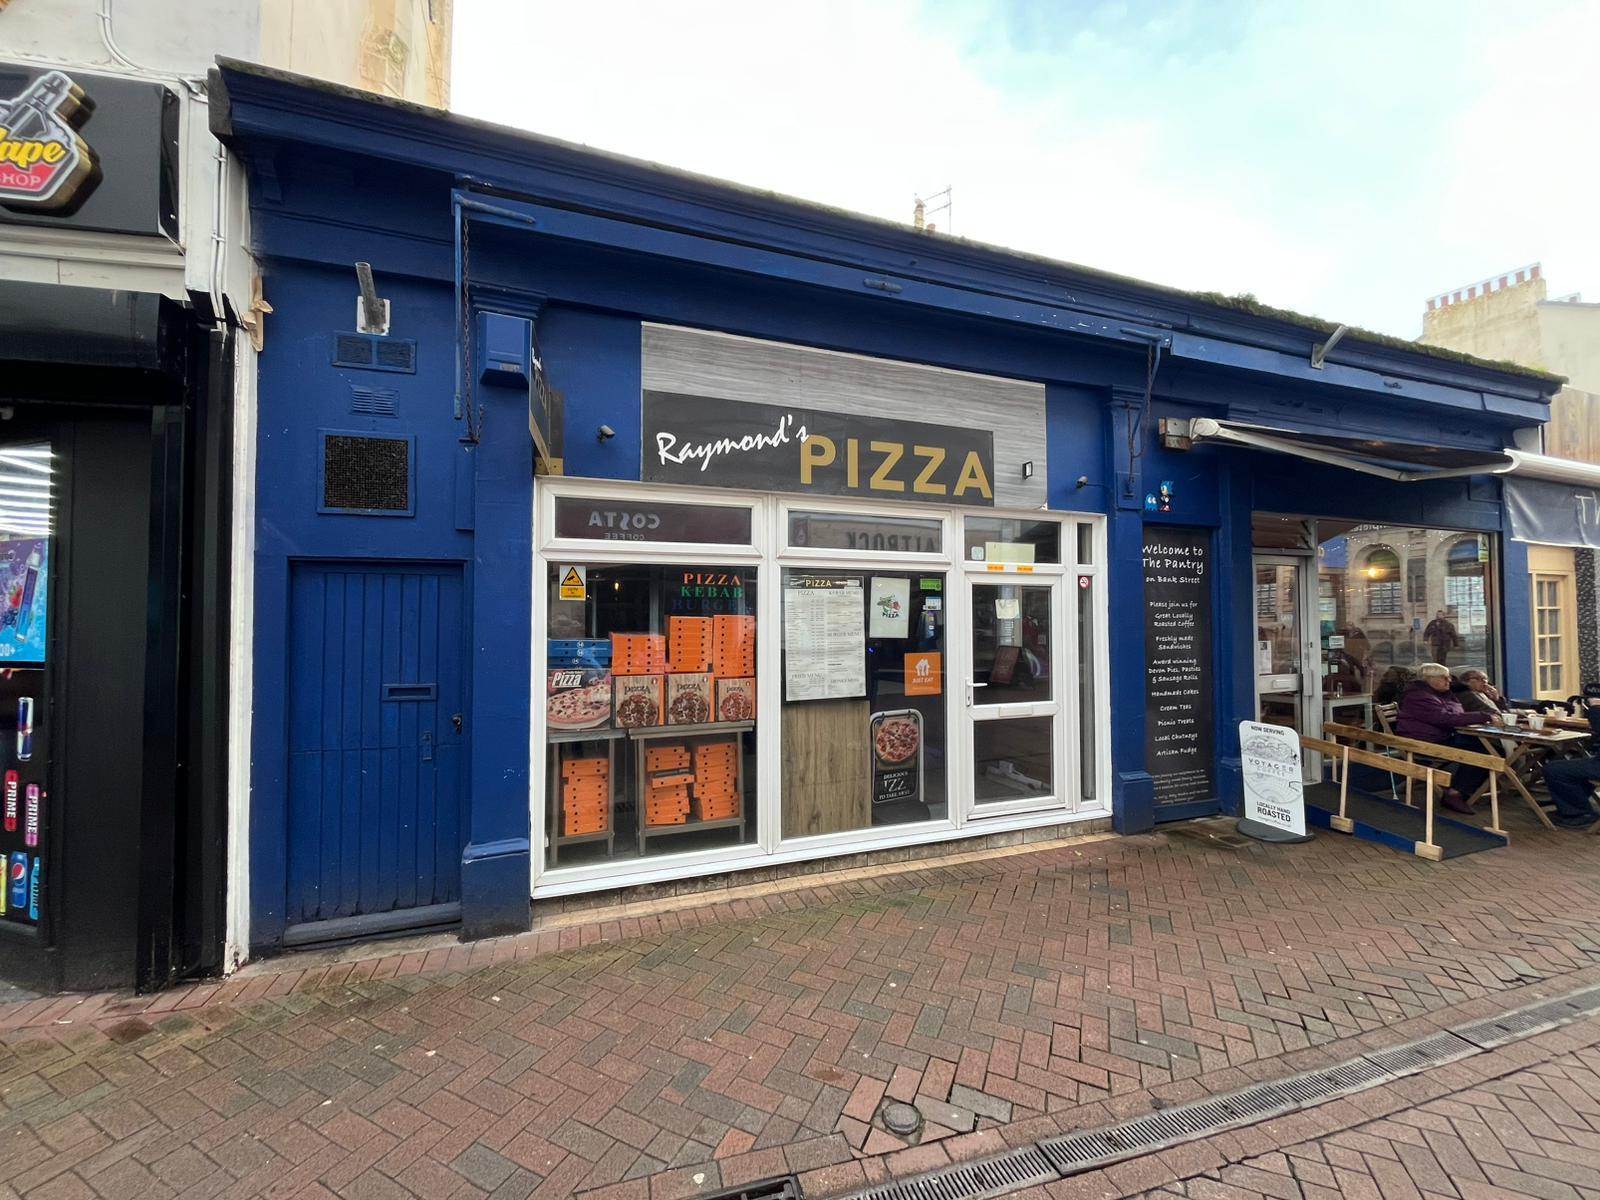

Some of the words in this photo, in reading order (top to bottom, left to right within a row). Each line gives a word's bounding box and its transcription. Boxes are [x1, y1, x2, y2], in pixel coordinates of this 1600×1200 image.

[0, 173, 41, 187] HOP
[656, 415, 809, 471] Raymond's
[800, 435, 993, 498] PIZZA
[1142, 544, 1190, 556] Welcome
[1193, 547, 1203, 556] to
[1142, 558, 1161, 569] The
[1164, 558, 1204, 575] Pantry
[683, 572, 741, 586] PIZZA
[805, 579, 832, 588] PIZZA
[1157, 575, 1178, 584] Bank
[1179, 576, 1201, 584] Street
[681, 586, 744, 598] KEBAB
[1177, 620, 1195, 628] Coffee
[1155, 635, 1178, 644] Freshly
[1172, 657, 1197, 667] winning
[552, 672, 582, 688] Pizza
[1157, 675, 1182, 683] Sausage
[1250, 725, 1262, 733] NOW
[1263, 727, 1285, 736] SERVING
[1248, 758, 1294, 773] VOYAGER
[7, 781, 17, 818] PRIME
[1256, 801, 1276, 811] LOCALLY
[28, 795, 38, 833] PRIME
[1257, 806, 1291, 822] ROASTED
